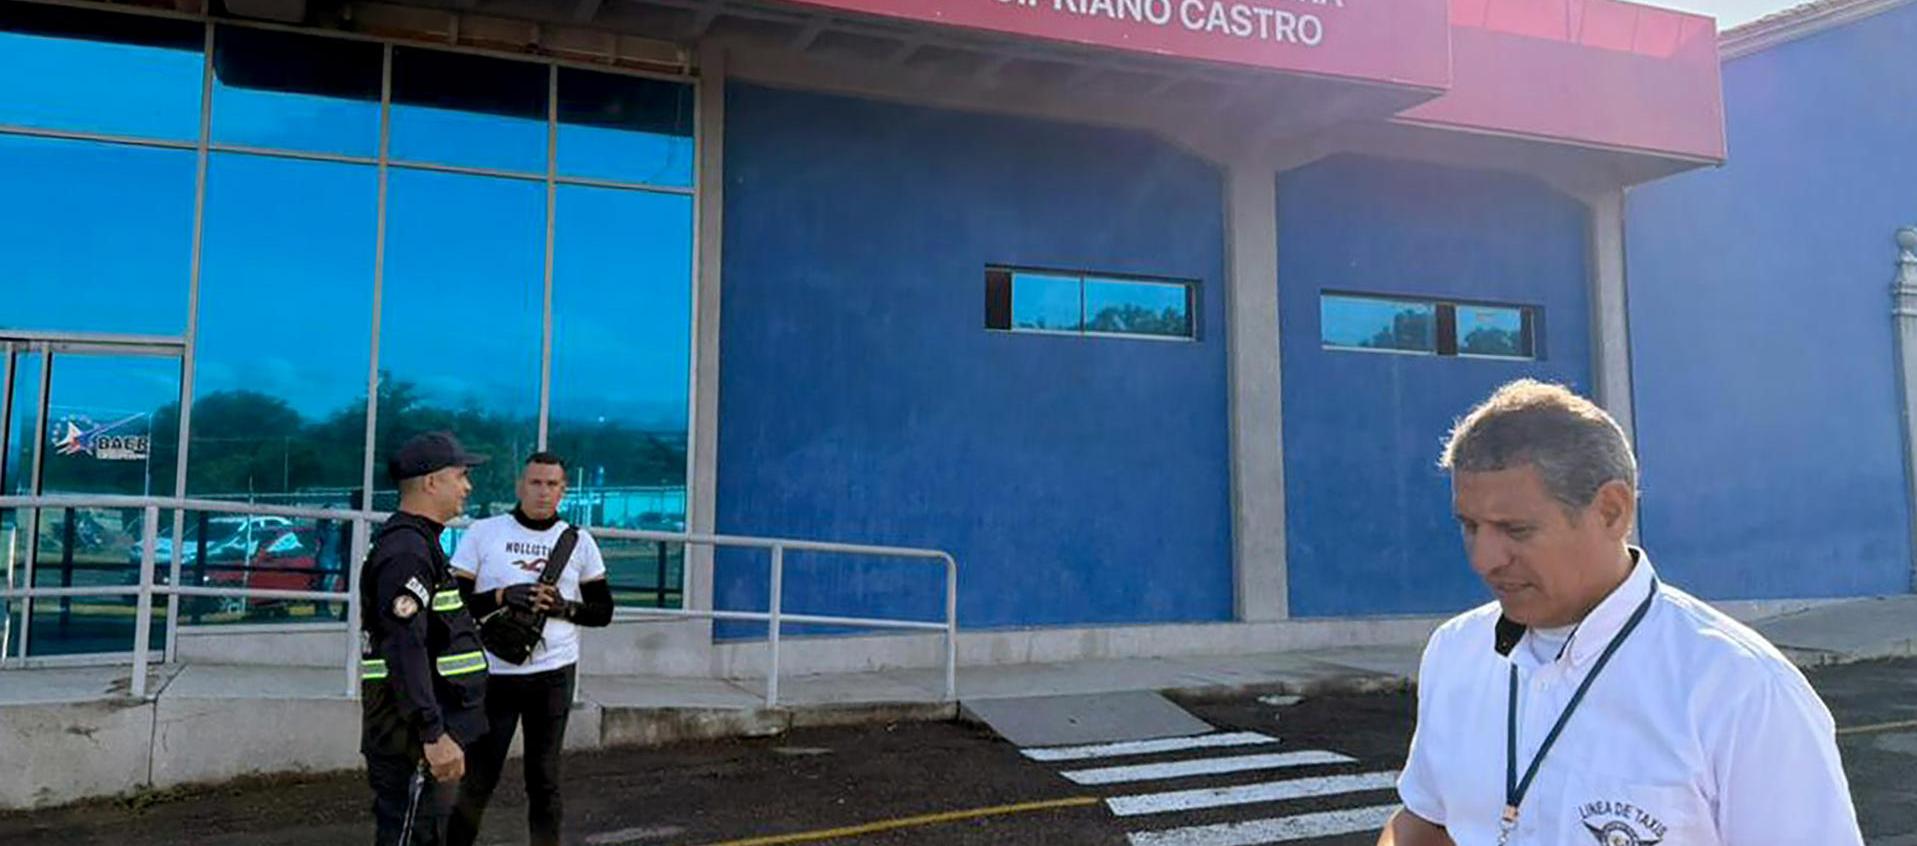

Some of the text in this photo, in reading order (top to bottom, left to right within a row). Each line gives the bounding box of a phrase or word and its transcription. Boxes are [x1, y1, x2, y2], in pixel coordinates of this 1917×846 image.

[998, 0, 1323, 45] IANO CASTRO
[1615, 802, 1632, 819] DE
[1634, 808, 1668, 838] TAXIS
